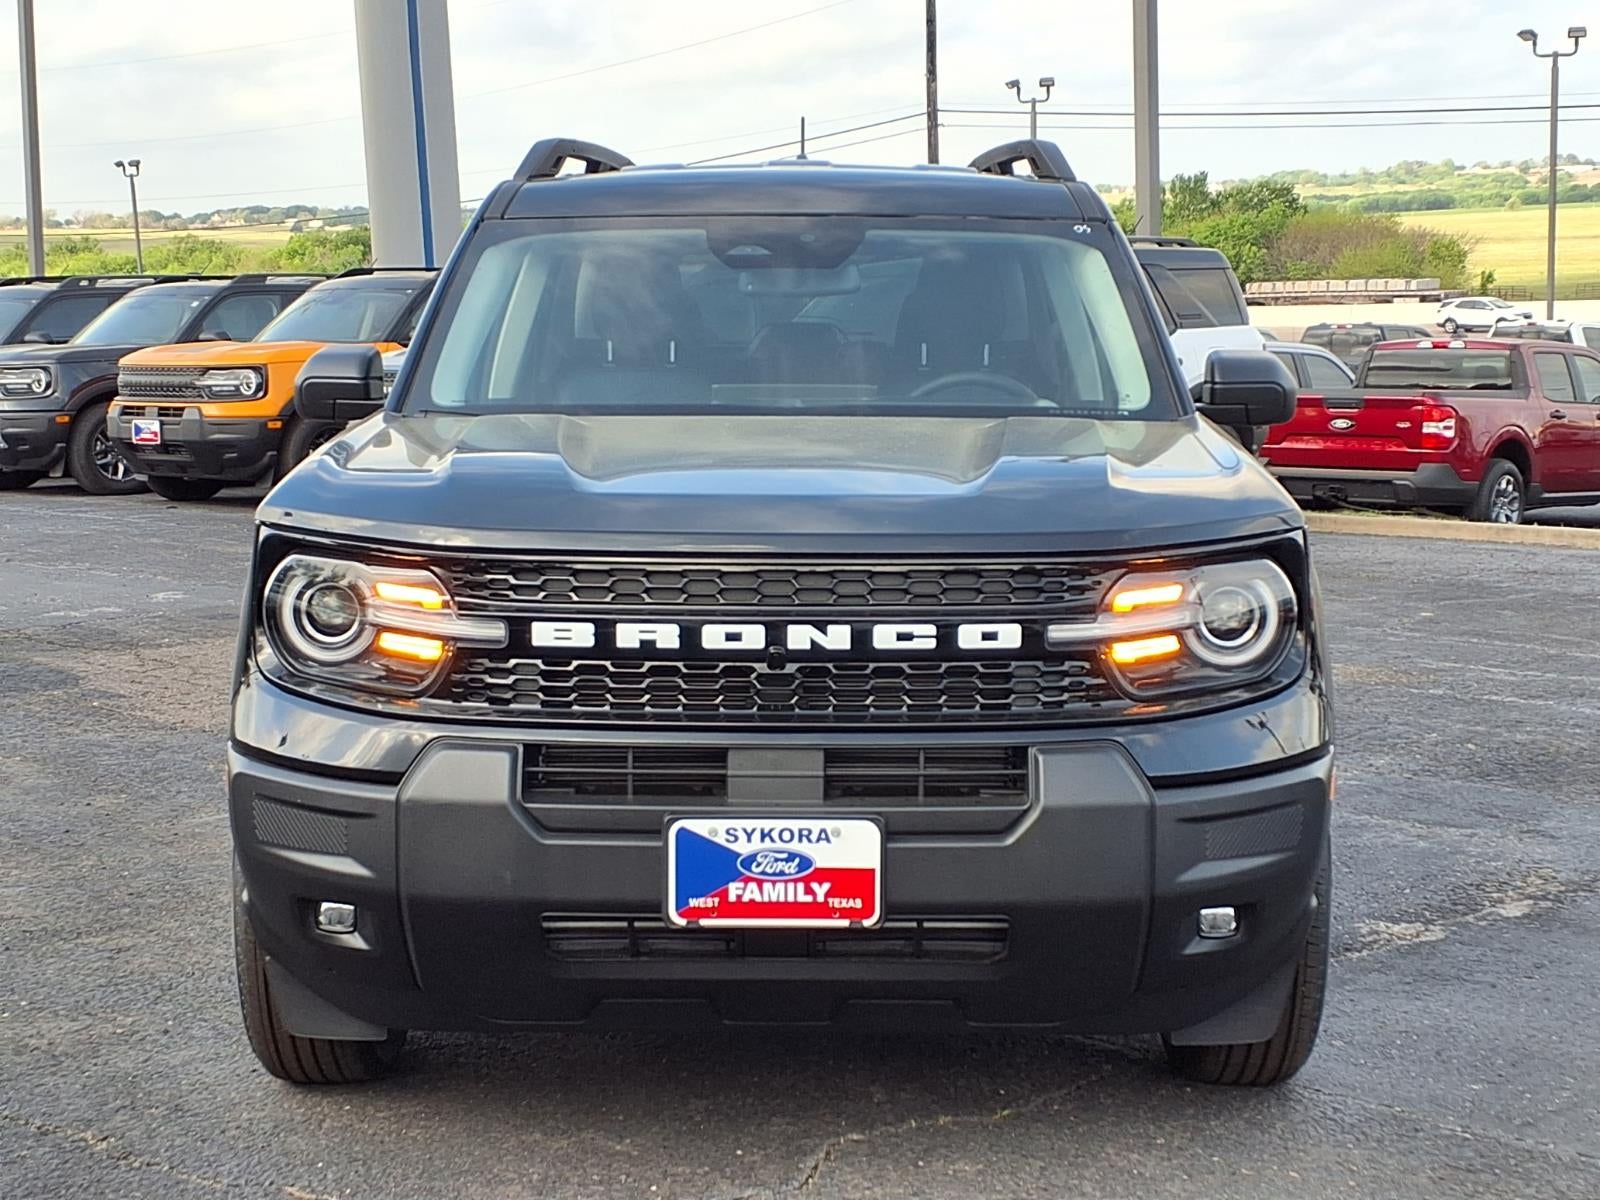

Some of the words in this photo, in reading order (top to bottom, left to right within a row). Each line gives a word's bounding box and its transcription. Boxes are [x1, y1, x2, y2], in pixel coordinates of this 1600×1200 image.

[531, 621, 1022, 649] BRONCO
[725, 827, 832, 844] SYKORA
[751, 851, 799, 874] Ford
[688, 897, 720, 908] WEST
[827, 897, 862, 909] TEXAS
[727, 881, 832, 903] FAMILY
